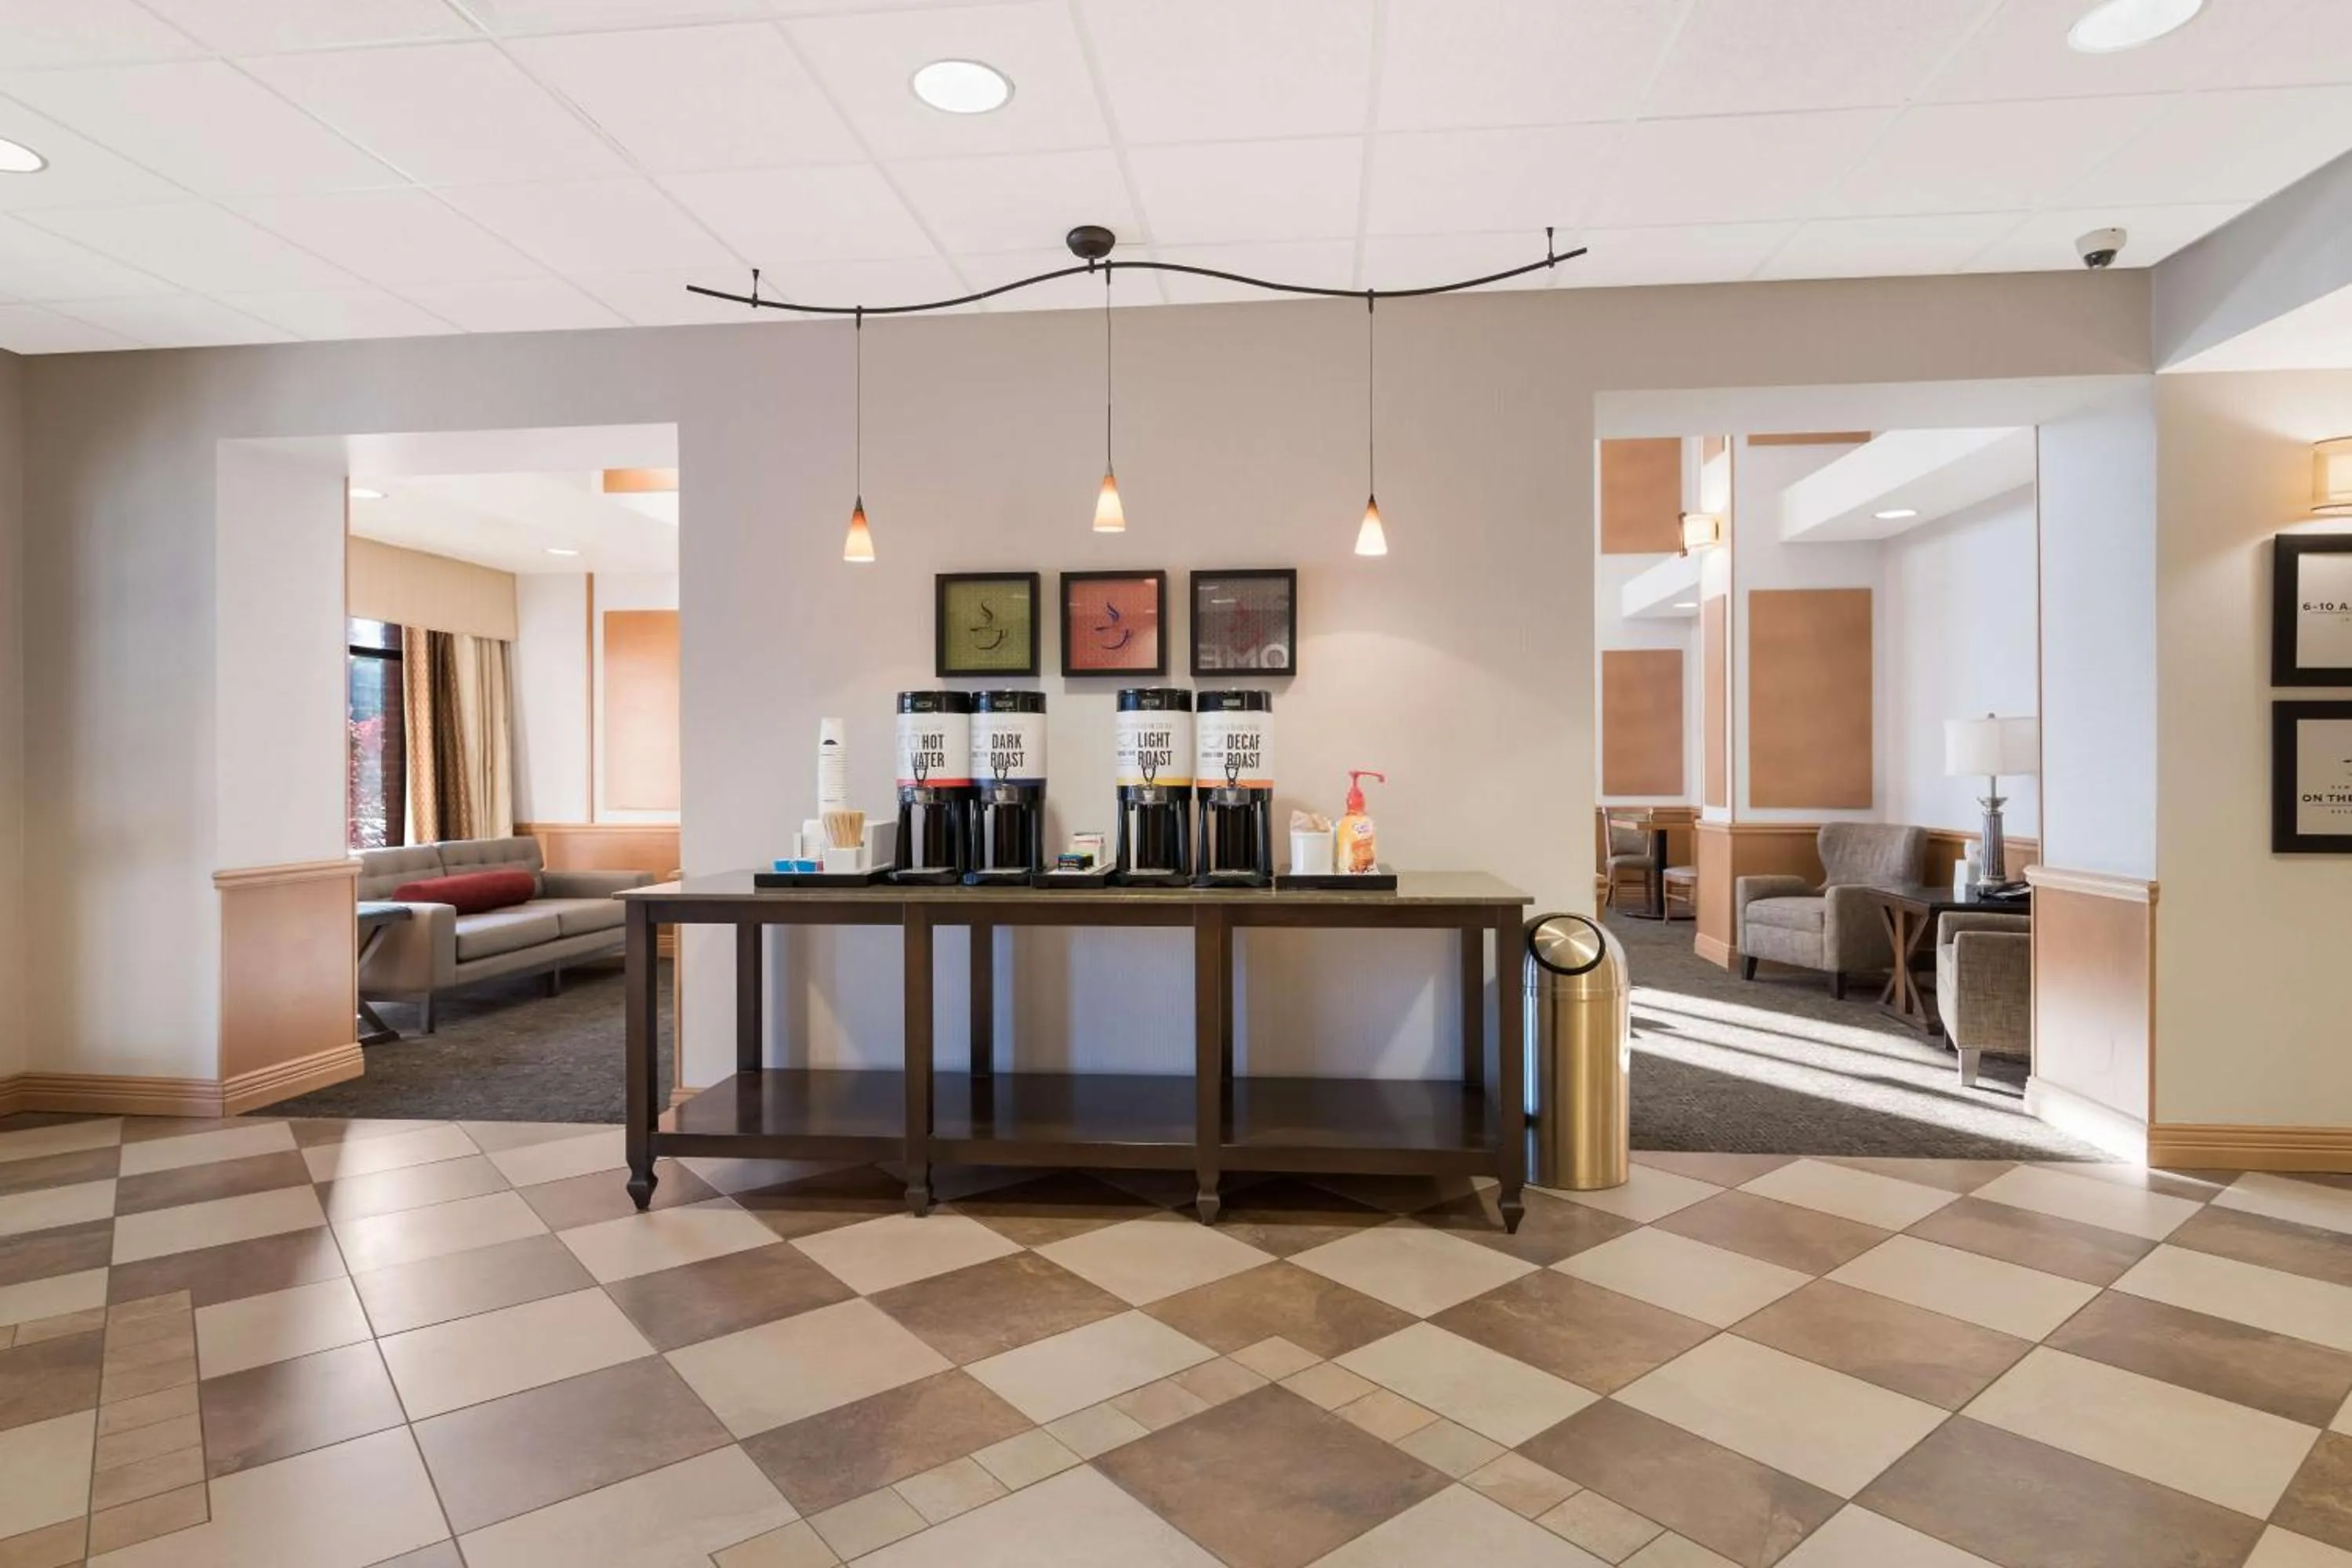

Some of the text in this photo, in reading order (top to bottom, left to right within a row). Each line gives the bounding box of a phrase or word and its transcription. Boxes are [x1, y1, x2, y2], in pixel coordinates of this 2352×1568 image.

[921, 734, 945, 750] HOT
[991, 733, 1022, 750] DARK
[1138, 731, 1171, 748] LIGHT
[1227, 733, 1261, 750] DECAF
[990, 752, 1025, 768] ROAST
[1138, 750, 1173, 766] ROAST
